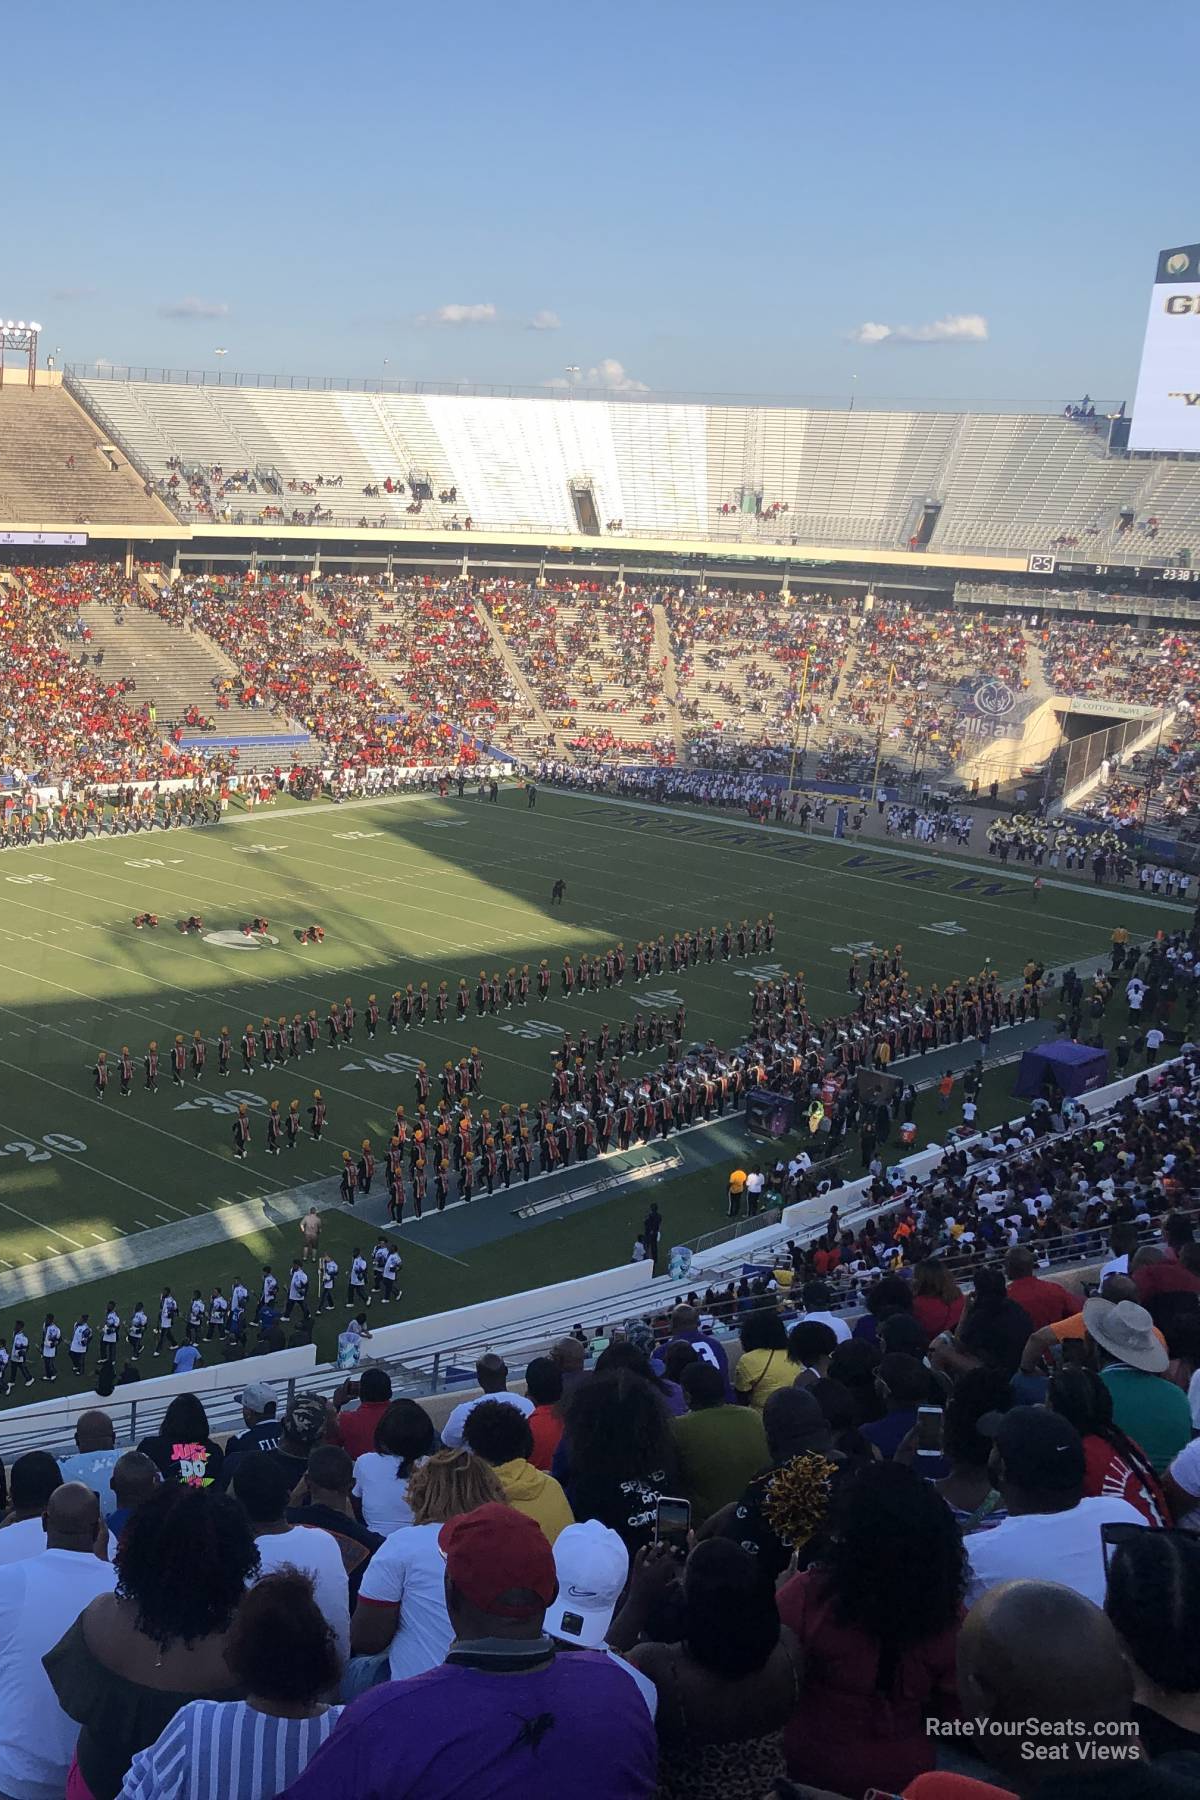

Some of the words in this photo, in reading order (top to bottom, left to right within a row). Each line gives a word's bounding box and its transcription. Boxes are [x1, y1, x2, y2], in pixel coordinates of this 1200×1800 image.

[1033, 558, 1050, 570] 25
[499, 1020, 566, 1039] 50
[193, 1089, 268, 1115] 30
[4, 1133, 88, 1163] 20
[180, 1460, 206, 1477] DO
